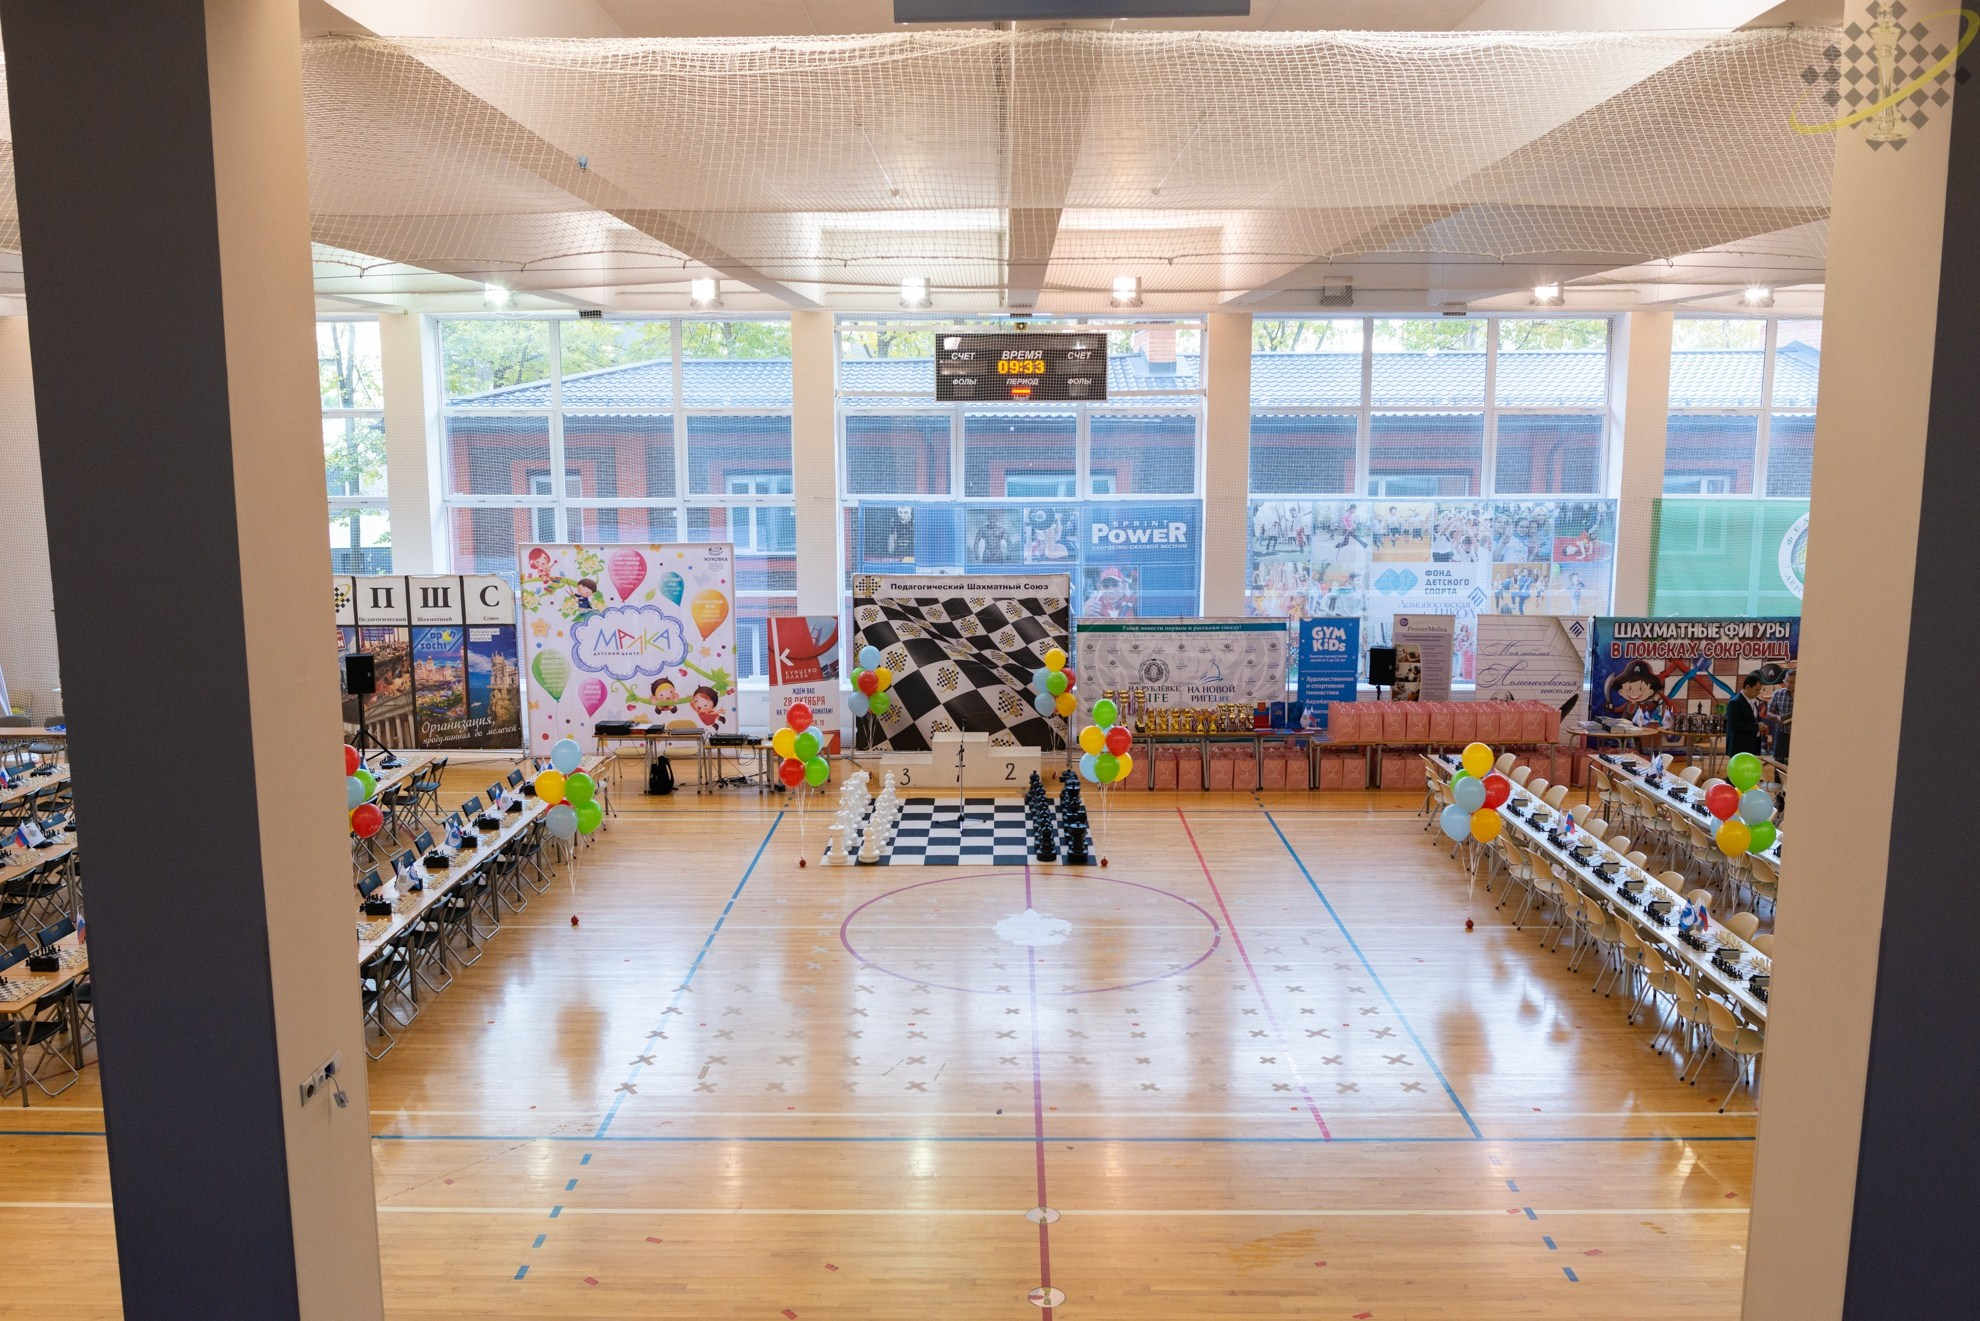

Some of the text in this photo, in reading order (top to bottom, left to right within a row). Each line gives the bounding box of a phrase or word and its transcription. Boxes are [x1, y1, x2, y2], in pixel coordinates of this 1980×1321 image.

[951, 352, 976, 360] СЧЕТ
[1002, 350, 1042, 360] ВРЕМЯ
[1067, 351, 1092, 360] СЧЕТ
[998, 360, 1045, 374] 09:33
[952, 378, 977, 386] ФОЛЫ
[1006, 378, 1040, 386] ПЕРИОД
[890, 583, 965, 592] Педагогический
[370, 587, 395, 608] П
[420, 587, 452, 608] Ш
[479, 585, 500, 607] С
[1312, 626, 1346, 640] GYM
[1614, 622, 1790, 638] ШАХМАТНЫЕ ФИГУРЫ
[420, 640, 447, 650] sochi
[1610, 641, 1791, 661] В ПОИСКАХ СОКРОВИЩ
[1202, 684, 1236, 693] НОВОЙ
[421, 716, 495, 737] Организация,
[900, 768, 911, 785] 3
[1005, 763, 1016, 780] 2
